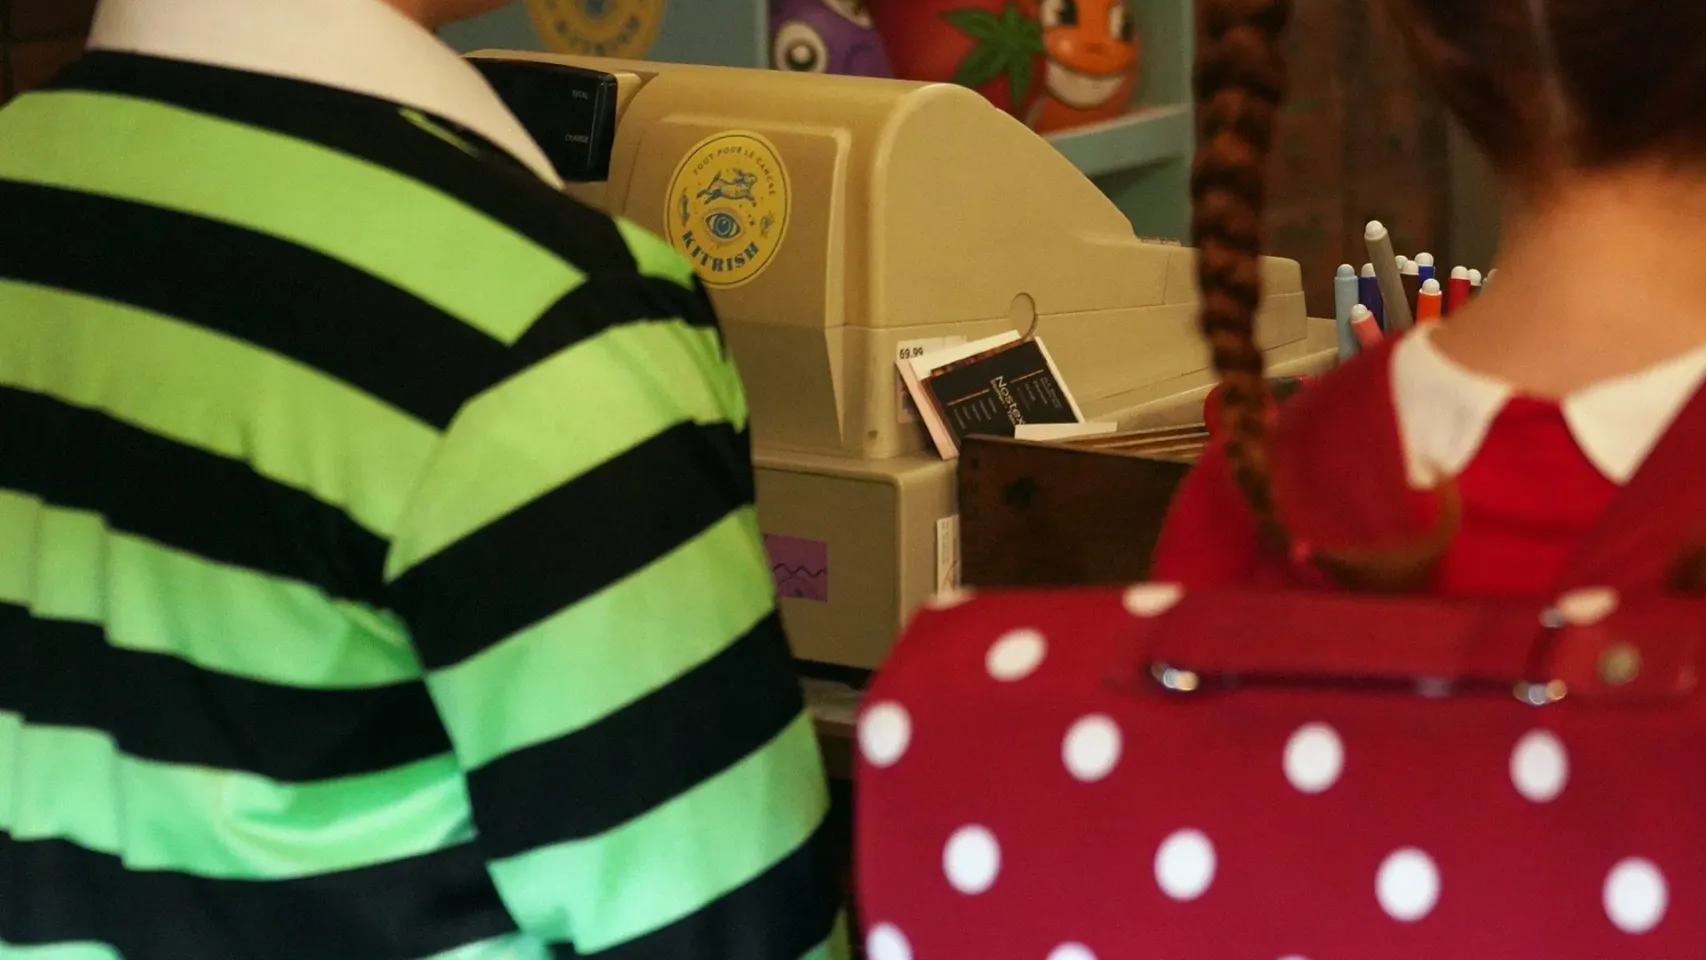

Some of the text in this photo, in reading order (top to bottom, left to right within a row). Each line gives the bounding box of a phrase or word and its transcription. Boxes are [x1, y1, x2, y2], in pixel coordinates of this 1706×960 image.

[717, 146, 742, 157] POUR
[744, 149, 755, 159] LE
[682, 230, 760, 273] KITRISH
[993, 375, 1026, 425] Nostex
